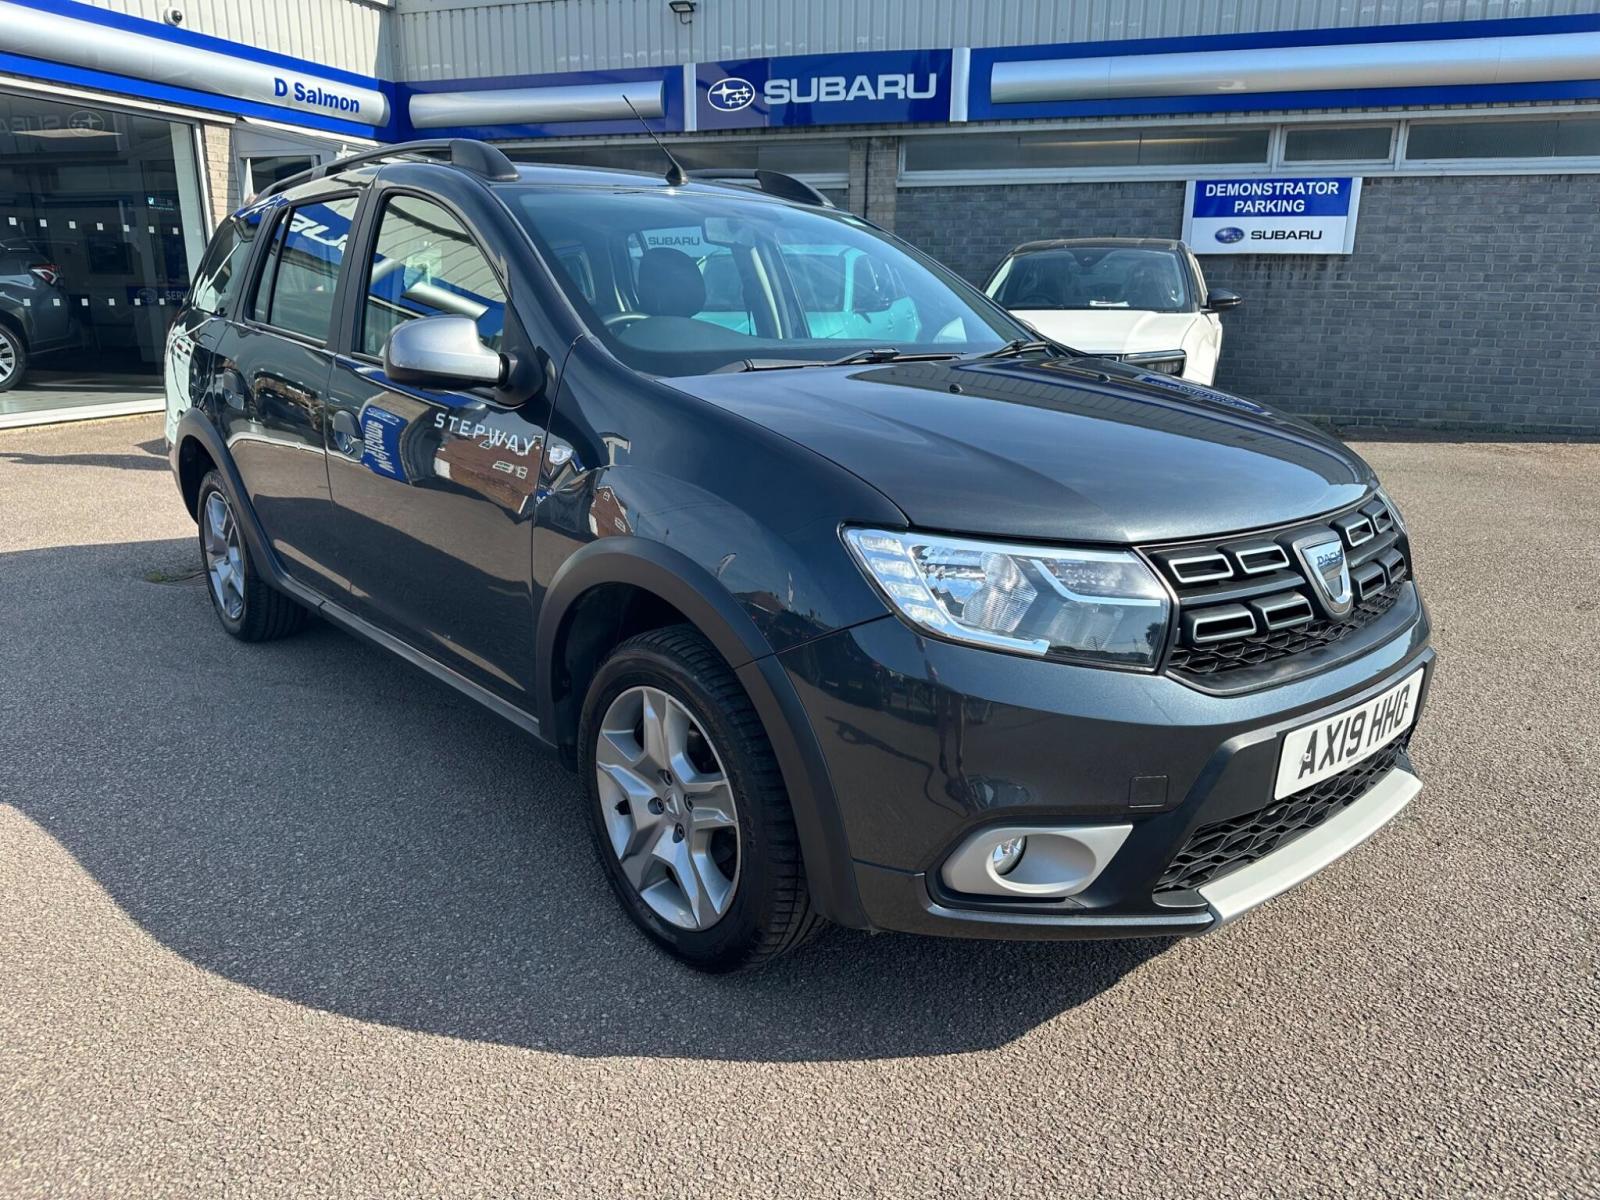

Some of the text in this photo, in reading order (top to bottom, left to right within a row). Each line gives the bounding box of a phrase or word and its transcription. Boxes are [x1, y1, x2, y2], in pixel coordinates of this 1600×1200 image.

[274, 77, 360, 113] D Salmon
[764, 73, 937, 105] SUBARU
[1205, 181, 1339, 197] DEMONSTRATOR
[1234, 199, 1305, 213] PARKING
[647, 235, 701, 246] SUBARU
[1250, 230, 1323, 240] SUBARU
[434, 412, 537, 456] STEPWAY
[1298, 710, 1367, 779] AX19
